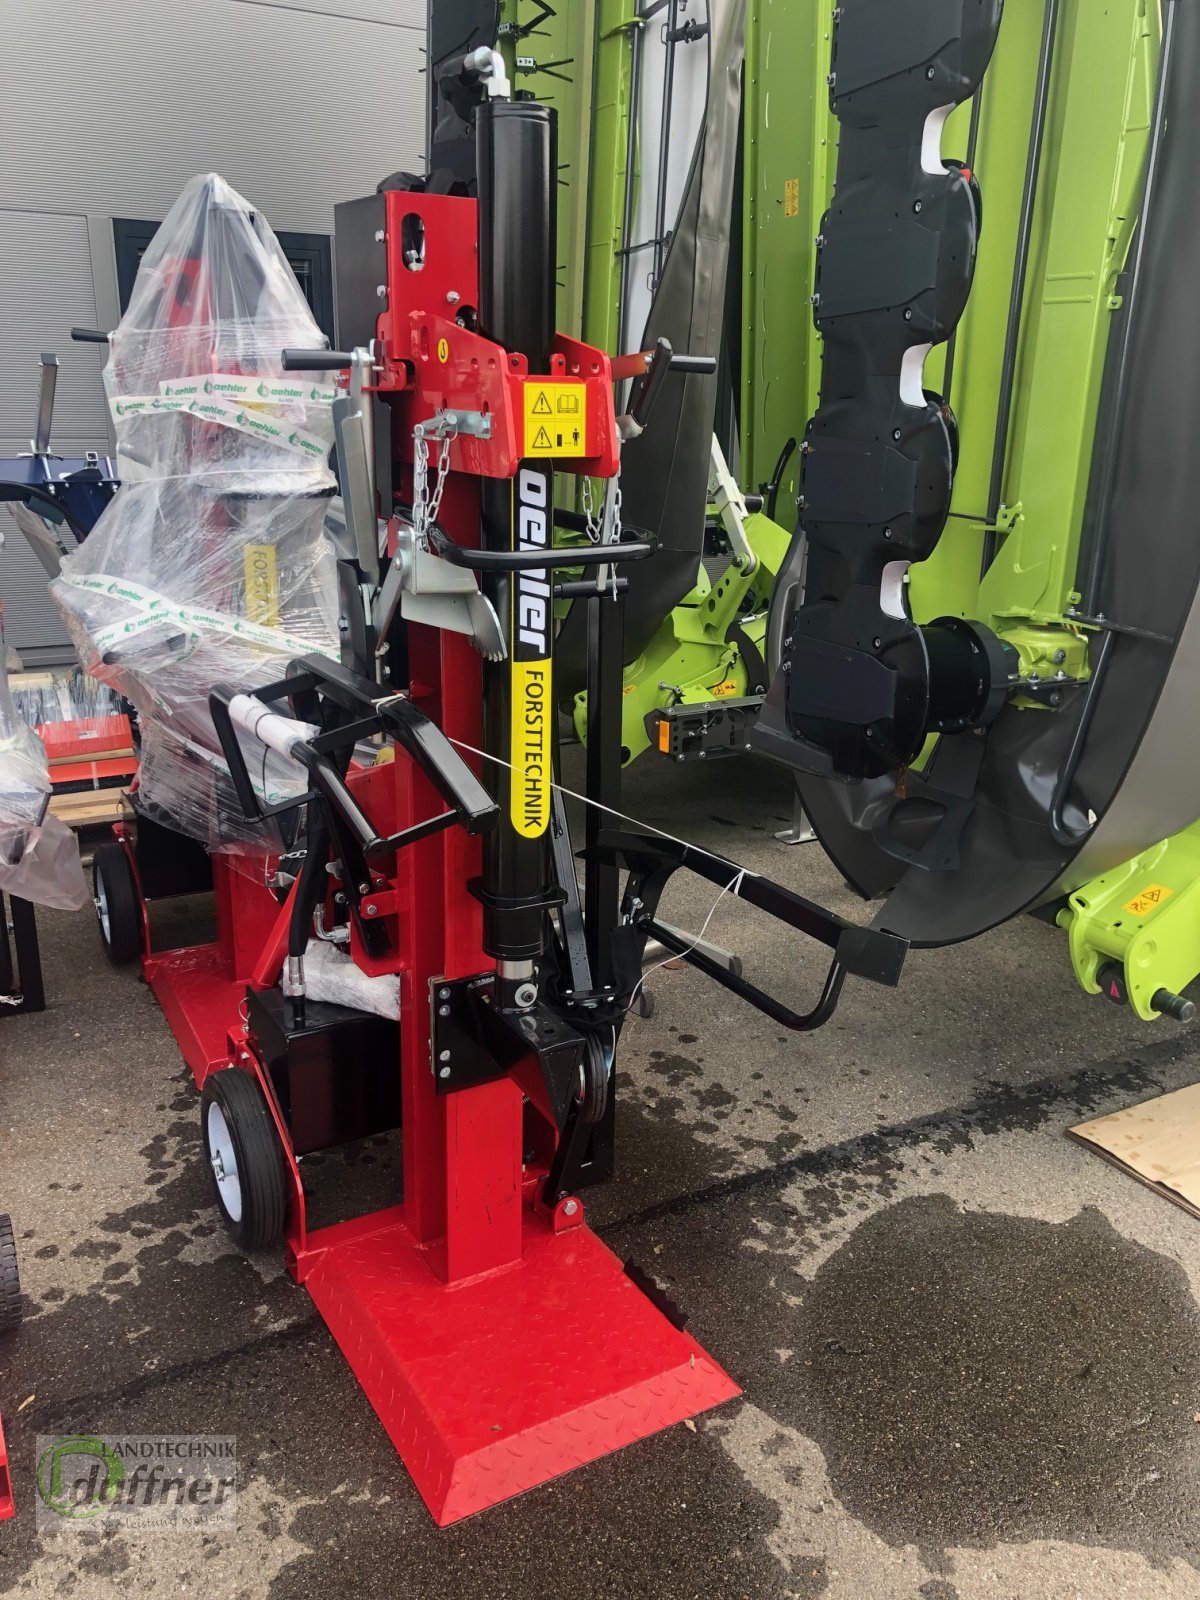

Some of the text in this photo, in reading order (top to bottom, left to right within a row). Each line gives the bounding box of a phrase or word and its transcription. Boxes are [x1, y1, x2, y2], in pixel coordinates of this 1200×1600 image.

[213, 383, 248, 393] oehler
[270, 388, 304, 397] oehler
[198, 404, 228, 417] oehler
[249, 419, 281, 436] oehler
[524, 670, 544, 828] FORSTTECHNIK
